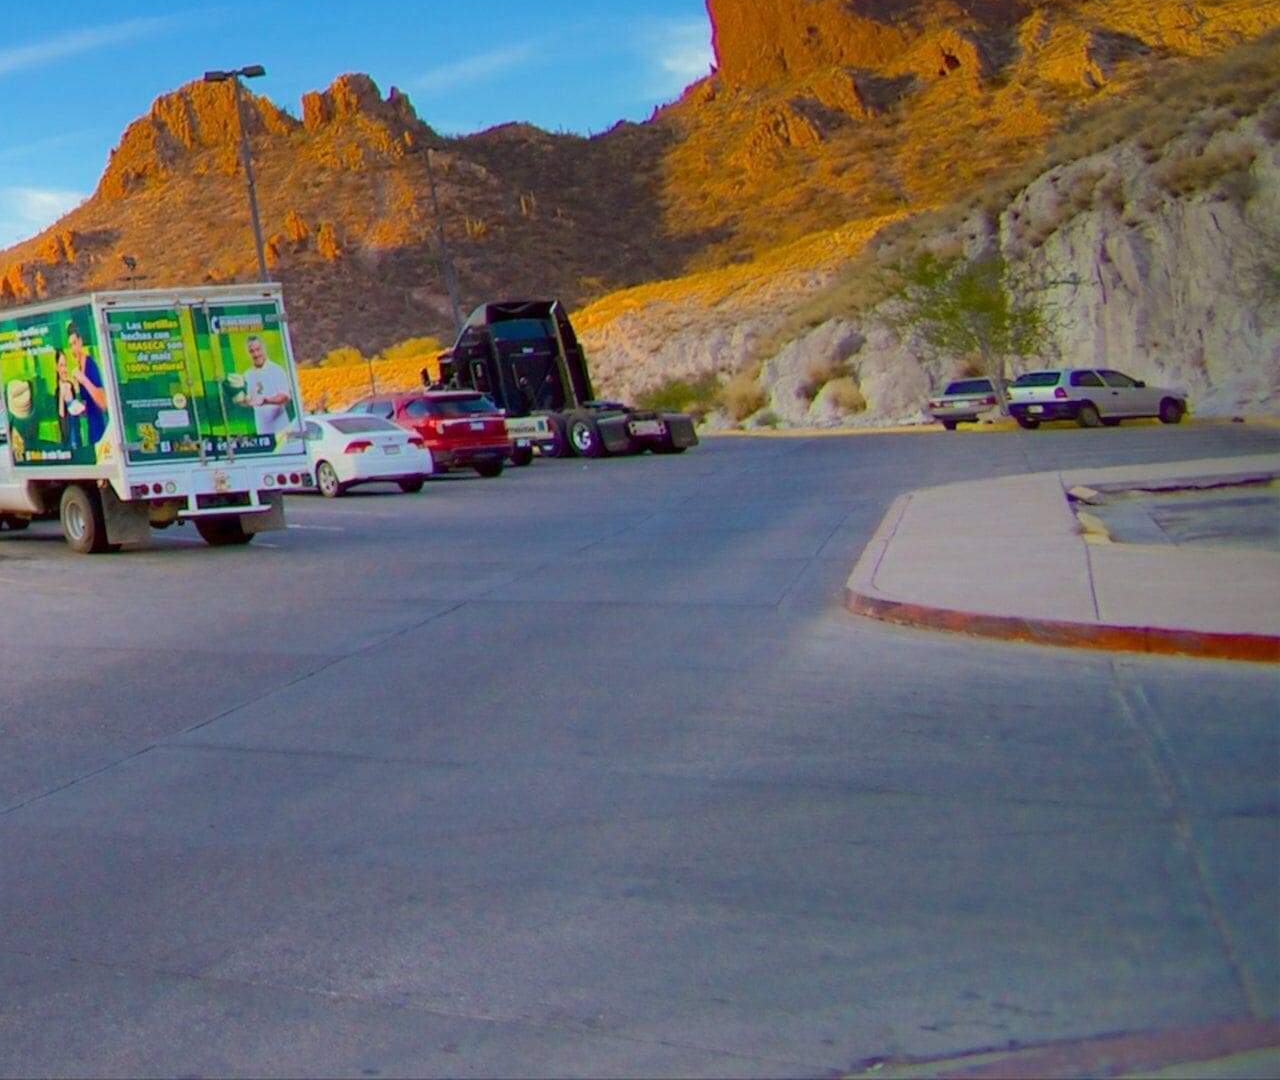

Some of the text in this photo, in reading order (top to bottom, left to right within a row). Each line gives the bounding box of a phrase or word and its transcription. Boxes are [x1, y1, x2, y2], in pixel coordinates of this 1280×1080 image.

[126, 319, 178, 330] Las tortillas
[121, 331, 170, 341] hechas con
[127, 341, 183, 352] MASECA son
[127, 360, 184, 372] 100% natural
